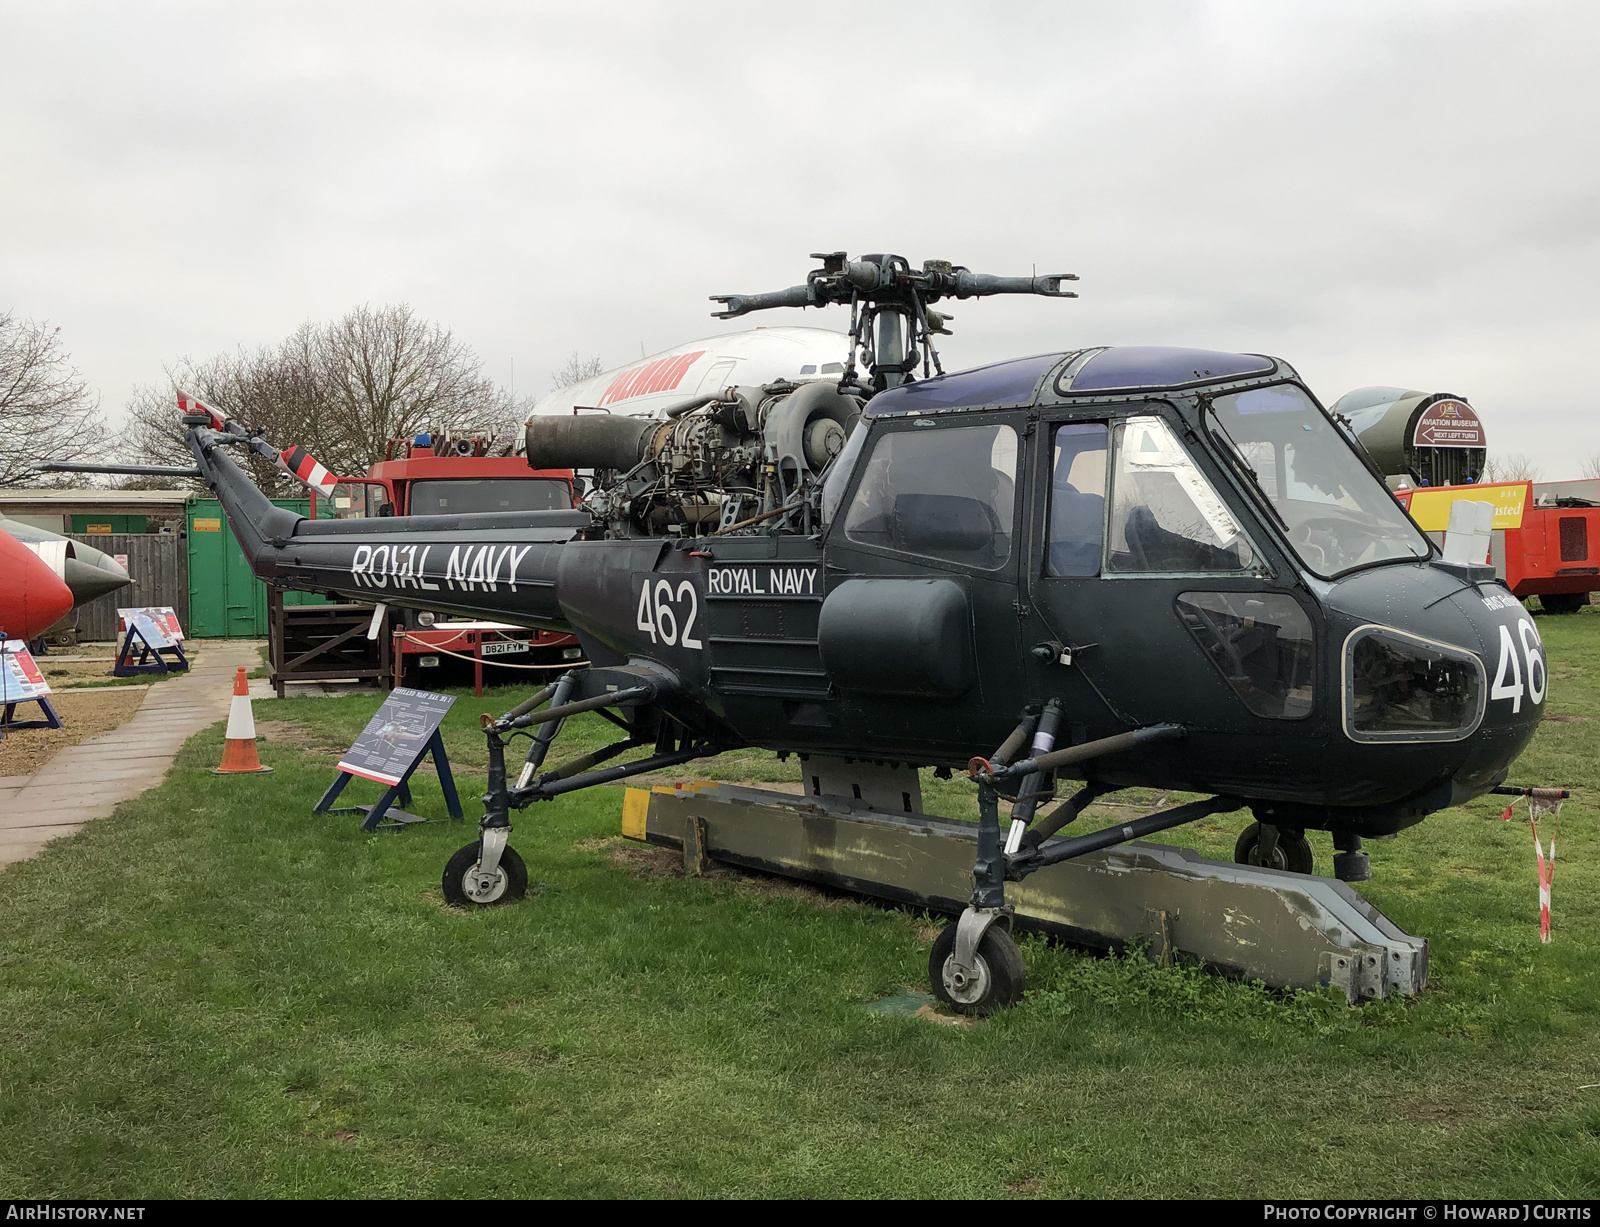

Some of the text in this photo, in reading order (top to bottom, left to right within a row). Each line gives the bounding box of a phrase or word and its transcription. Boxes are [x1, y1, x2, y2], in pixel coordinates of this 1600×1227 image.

[597, 350, 706, 407] PALMAIR
[351, 545, 532, 593] ROYAL NAVY
[708, 568, 817, 594] ROYAL NAVY
[637, 579, 703, 650] 462
[1481, 595, 1505, 611] HMS
[485, 643, 524, 653] D821 FYM
[1491, 618, 1548, 713] 46
